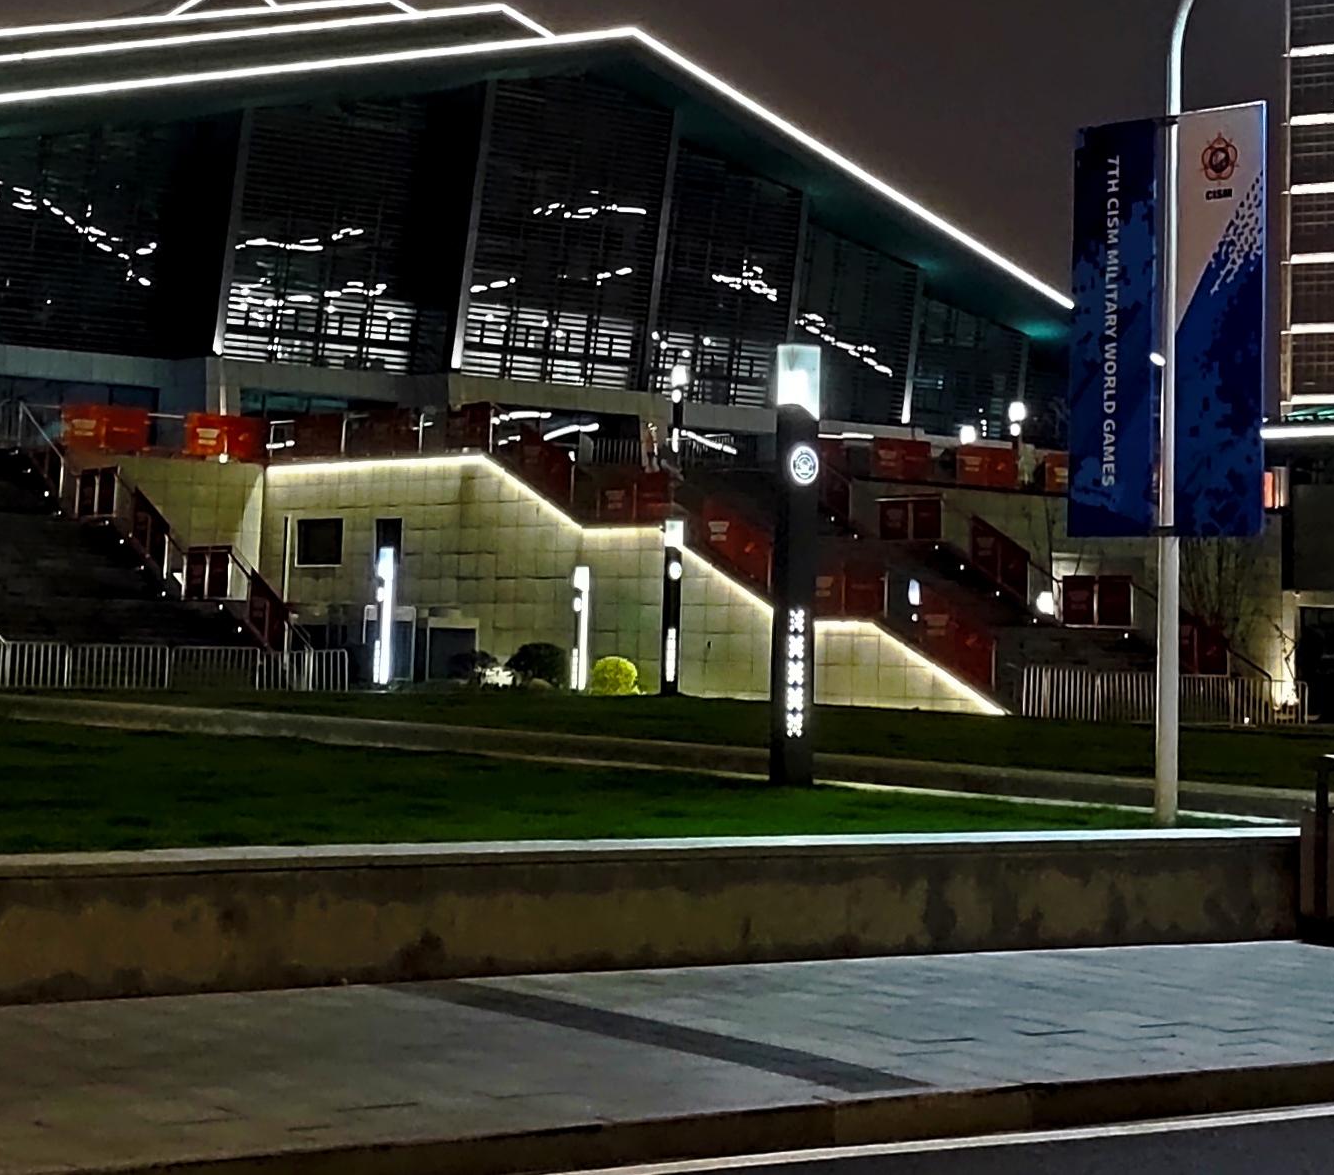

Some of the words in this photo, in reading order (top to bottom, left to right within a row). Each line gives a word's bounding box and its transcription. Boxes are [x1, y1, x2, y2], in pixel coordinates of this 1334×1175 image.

[1107, 154, 1120, 193] 7TH
[1107, 197, 1120, 244] CISM
[1104, 249, 1119, 338] MILITARY
[1103, 342, 1117, 414] WORLD
[1101, 418, 1116, 487] GAMES
